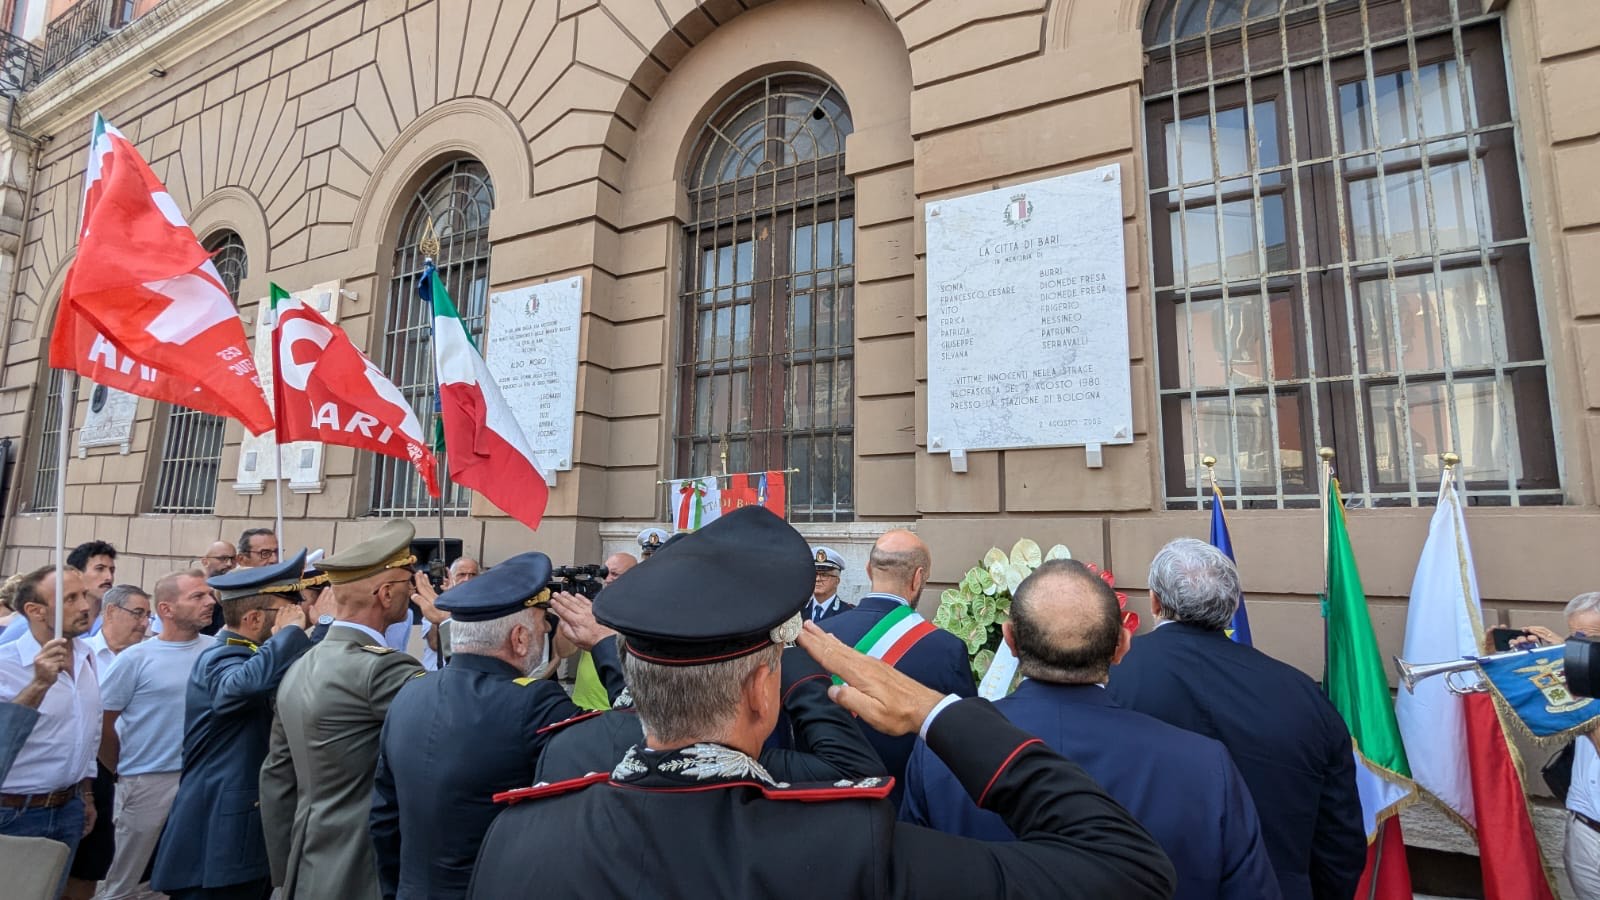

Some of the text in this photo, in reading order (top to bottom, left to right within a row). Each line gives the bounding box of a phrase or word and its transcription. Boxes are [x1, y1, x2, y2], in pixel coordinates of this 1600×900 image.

[979, 247, 990, 257] LA
[1024, 239, 1033, 249] DI
[1037, 234, 1059, 247] BARI
[1039, 267, 1062, 278] BURRI
[940, 283, 964, 293] SONIA
[1039, 273, 1106, 290] DIOMEDE FRESA
[940, 286, 1016, 305] FRANCESCO CESARE
[1040, 284, 1107, 302] DIOMEDE FRESA
[941, 305, 959, 316] VITO
[1040, 301, 1080, 313] FRIGERIO
[1041, 312, 1082, 325] MESSINEO
[940, 327, 970, 338] PATRIZIA
[1041, 325, 1080, 337] PATRUNO
[941, 338, 974, 350] GIUSEPPE
[1042, 336, 1089, 350] SERRAVALLI
[941, 350, 969, 361] SILVANA
[956, 374, 983, 386] VITTIME
[987, 370, 1028, 382] INNOCENTI
[1032, 367, 1057, 378] NELLA
[950, 377, 1100, 398] NEOFASCISTA DEL 2 AGOSTO 1980
[950, 391, 1101, 410] PRESSO LA STAZIONE DI BOLOGNA
[311, 401, 394, 444] ARI
